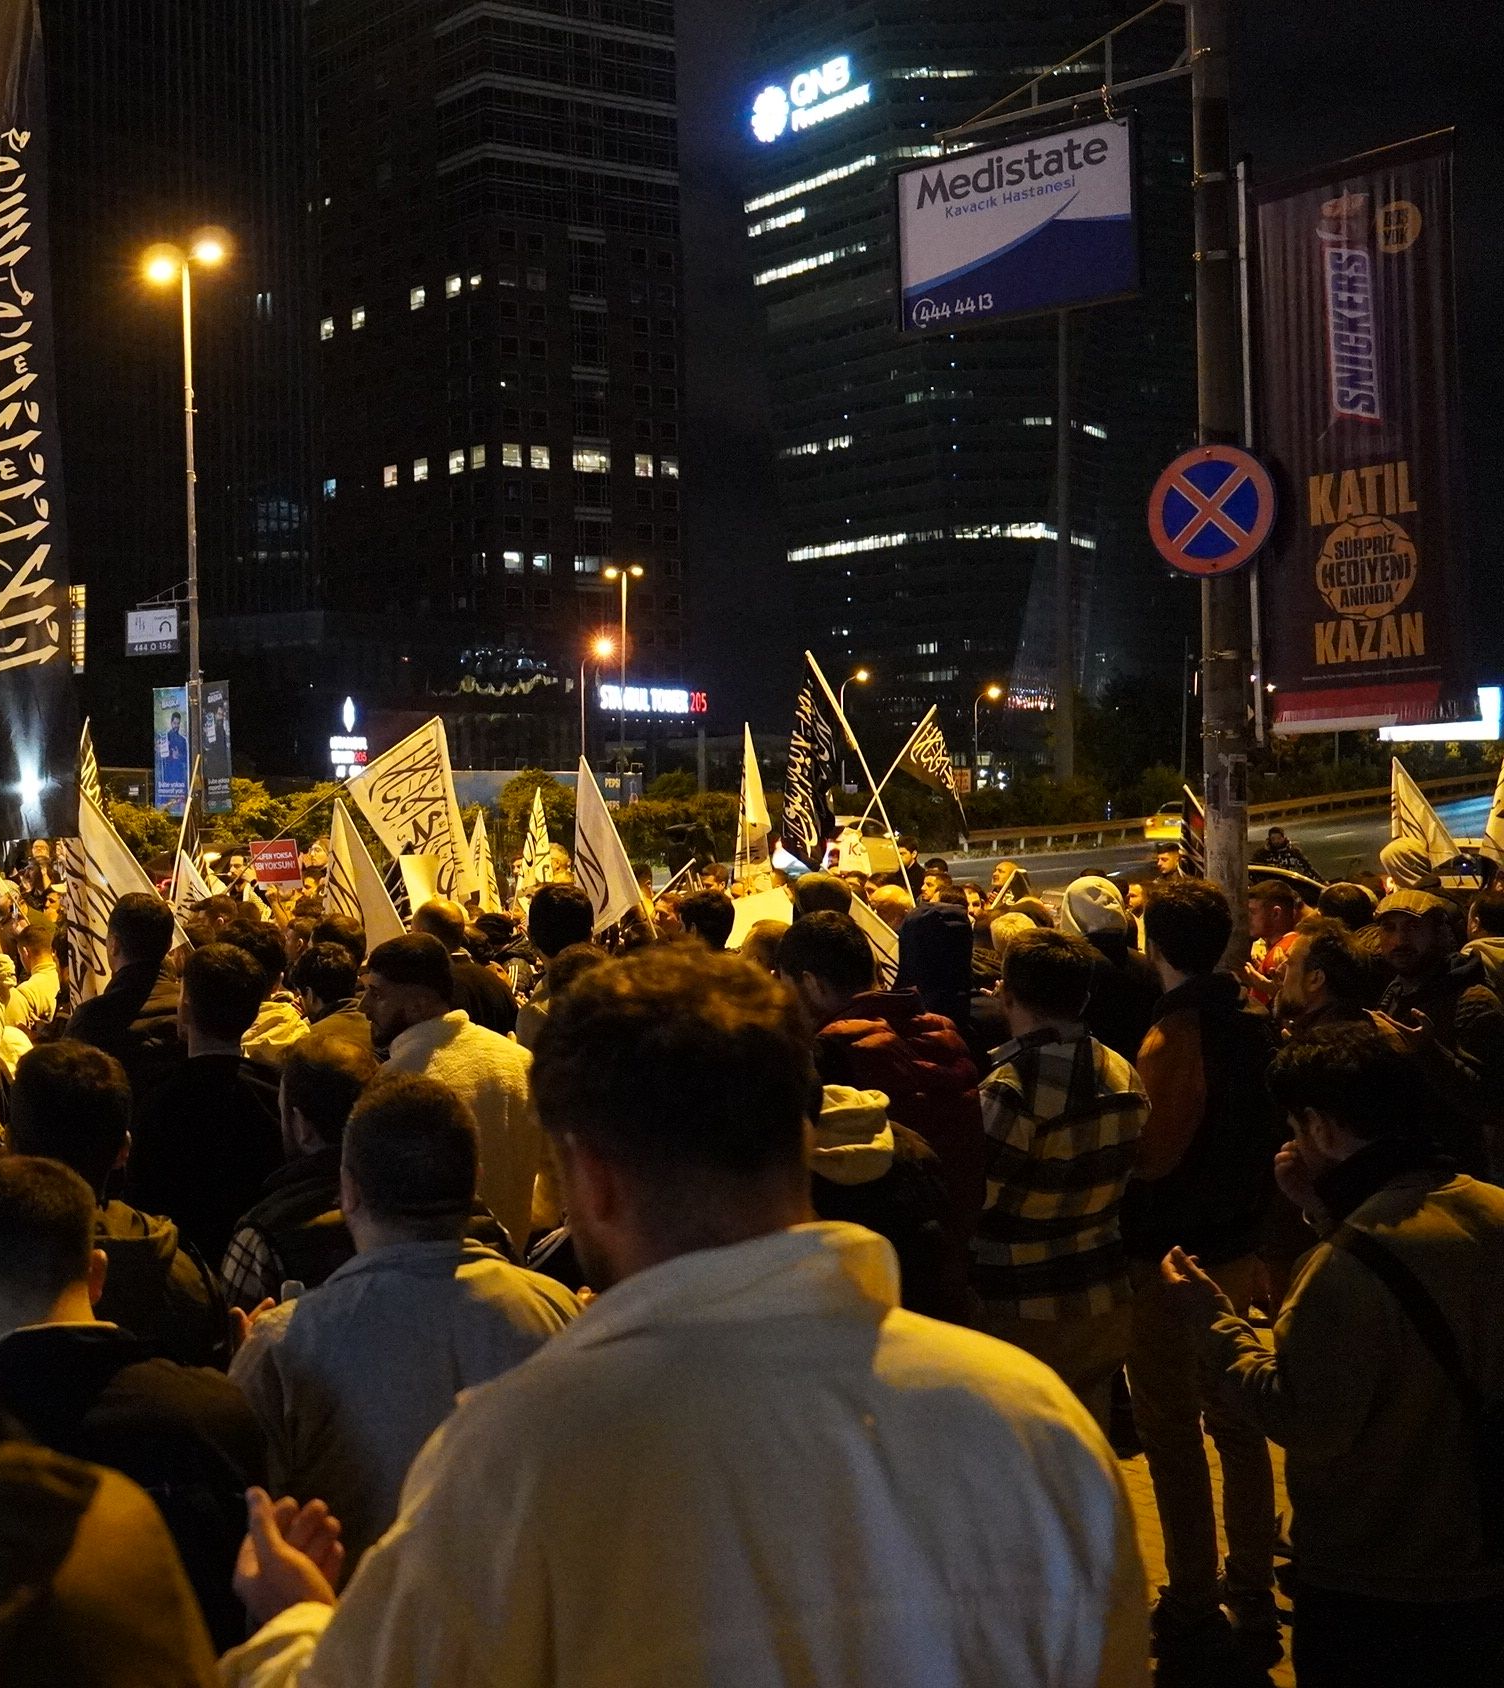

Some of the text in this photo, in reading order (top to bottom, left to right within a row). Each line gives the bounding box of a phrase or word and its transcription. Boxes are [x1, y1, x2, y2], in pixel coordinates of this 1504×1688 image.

[790, 55, 850, 106] QNB
[916, 137, 1108, 210] Medistate
[945, 175, 1076, 219] Kavacık Hastanesi
[920, 302, 951, 322] 444
[1329, 251, 1376, 415] SNICKERS
[1308, 460, 1418, 527] KATIL
[1333, 531, 1395, 560] SÜRPRİZ
[1322, 553, 1411, 589] HEDİYENİ
[1340, 584, 1394, 608] ANINDA
[1314, 611, 1425, 665] KAZAN
[690, 692, 708, 712] 205
[273, 851, 293, 859] YOKSA
